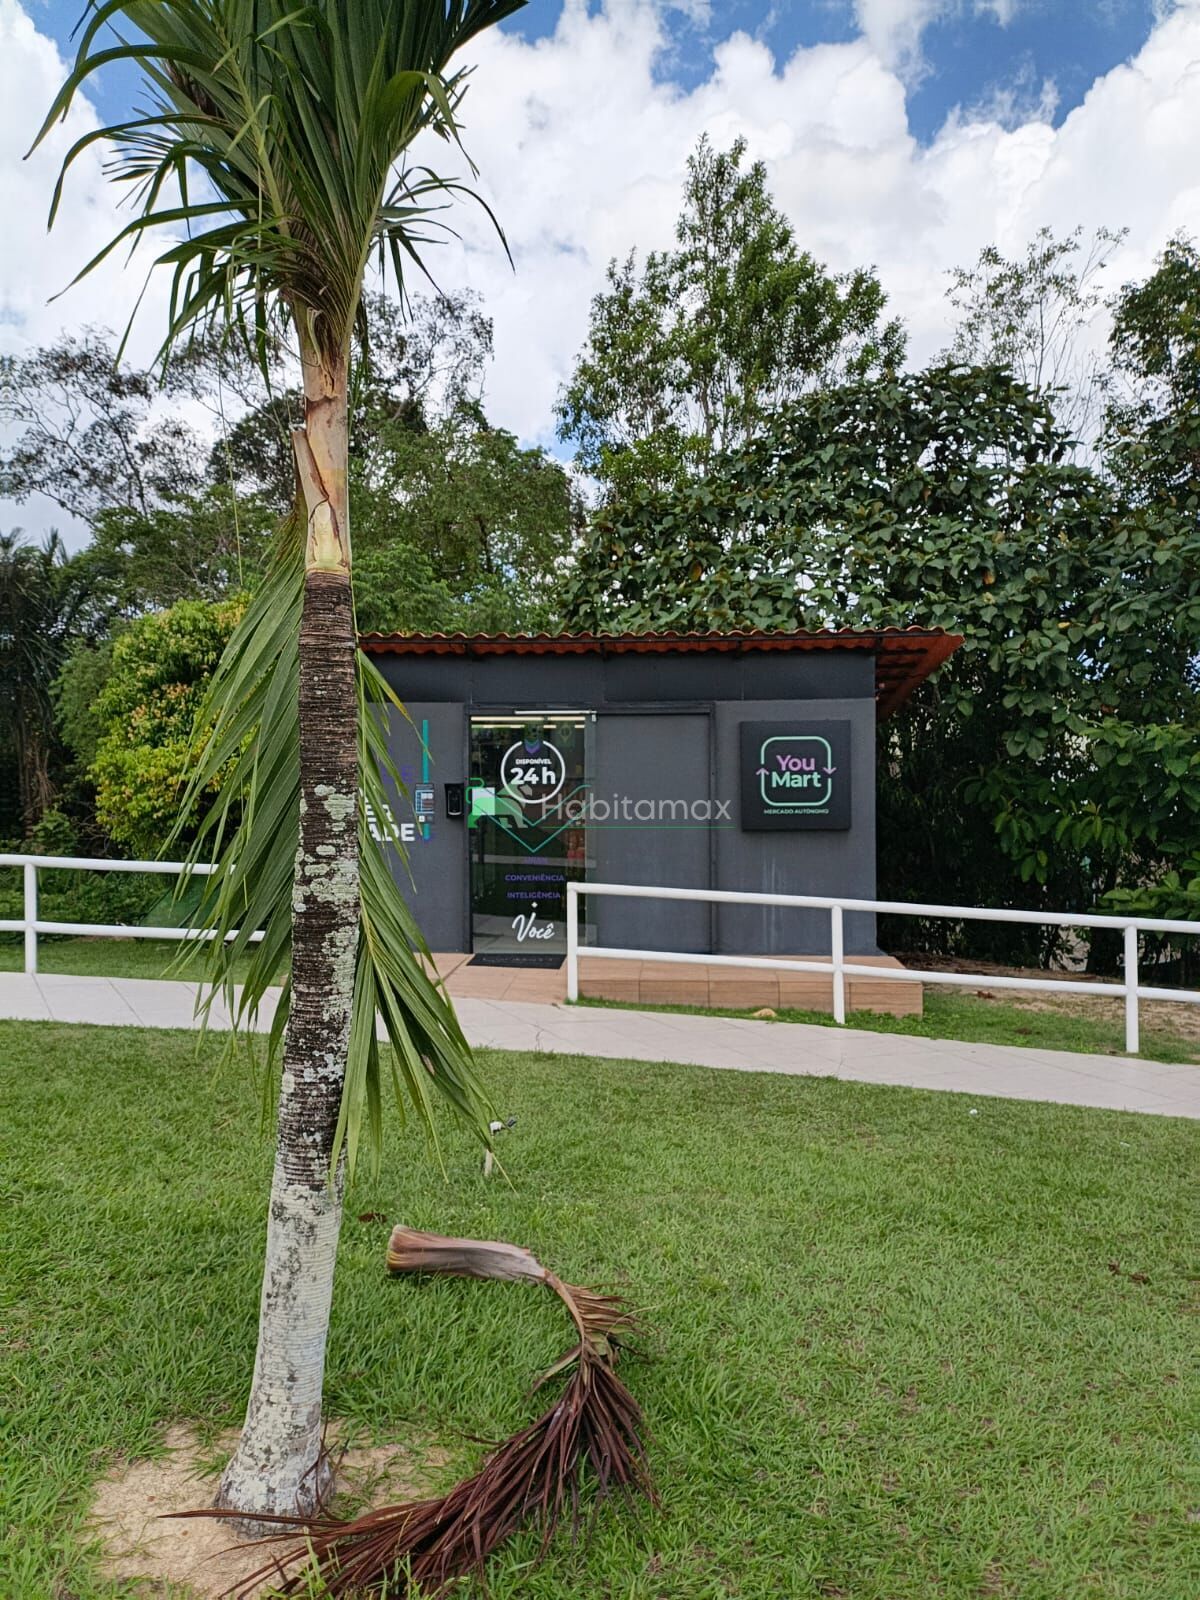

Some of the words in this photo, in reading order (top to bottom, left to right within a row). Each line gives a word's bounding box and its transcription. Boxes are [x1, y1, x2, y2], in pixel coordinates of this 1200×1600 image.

[515, 757, 552, 765] DISPONÍVEL
[776, 754, 815, 771] You
[771, 771, 822, 788] Mart
[505, 873, 565, 881] CONVENIÊNCIA
[507, 891, 561, 899] INTELIGÊNCIA
[511, 911, 555, 943] Você
